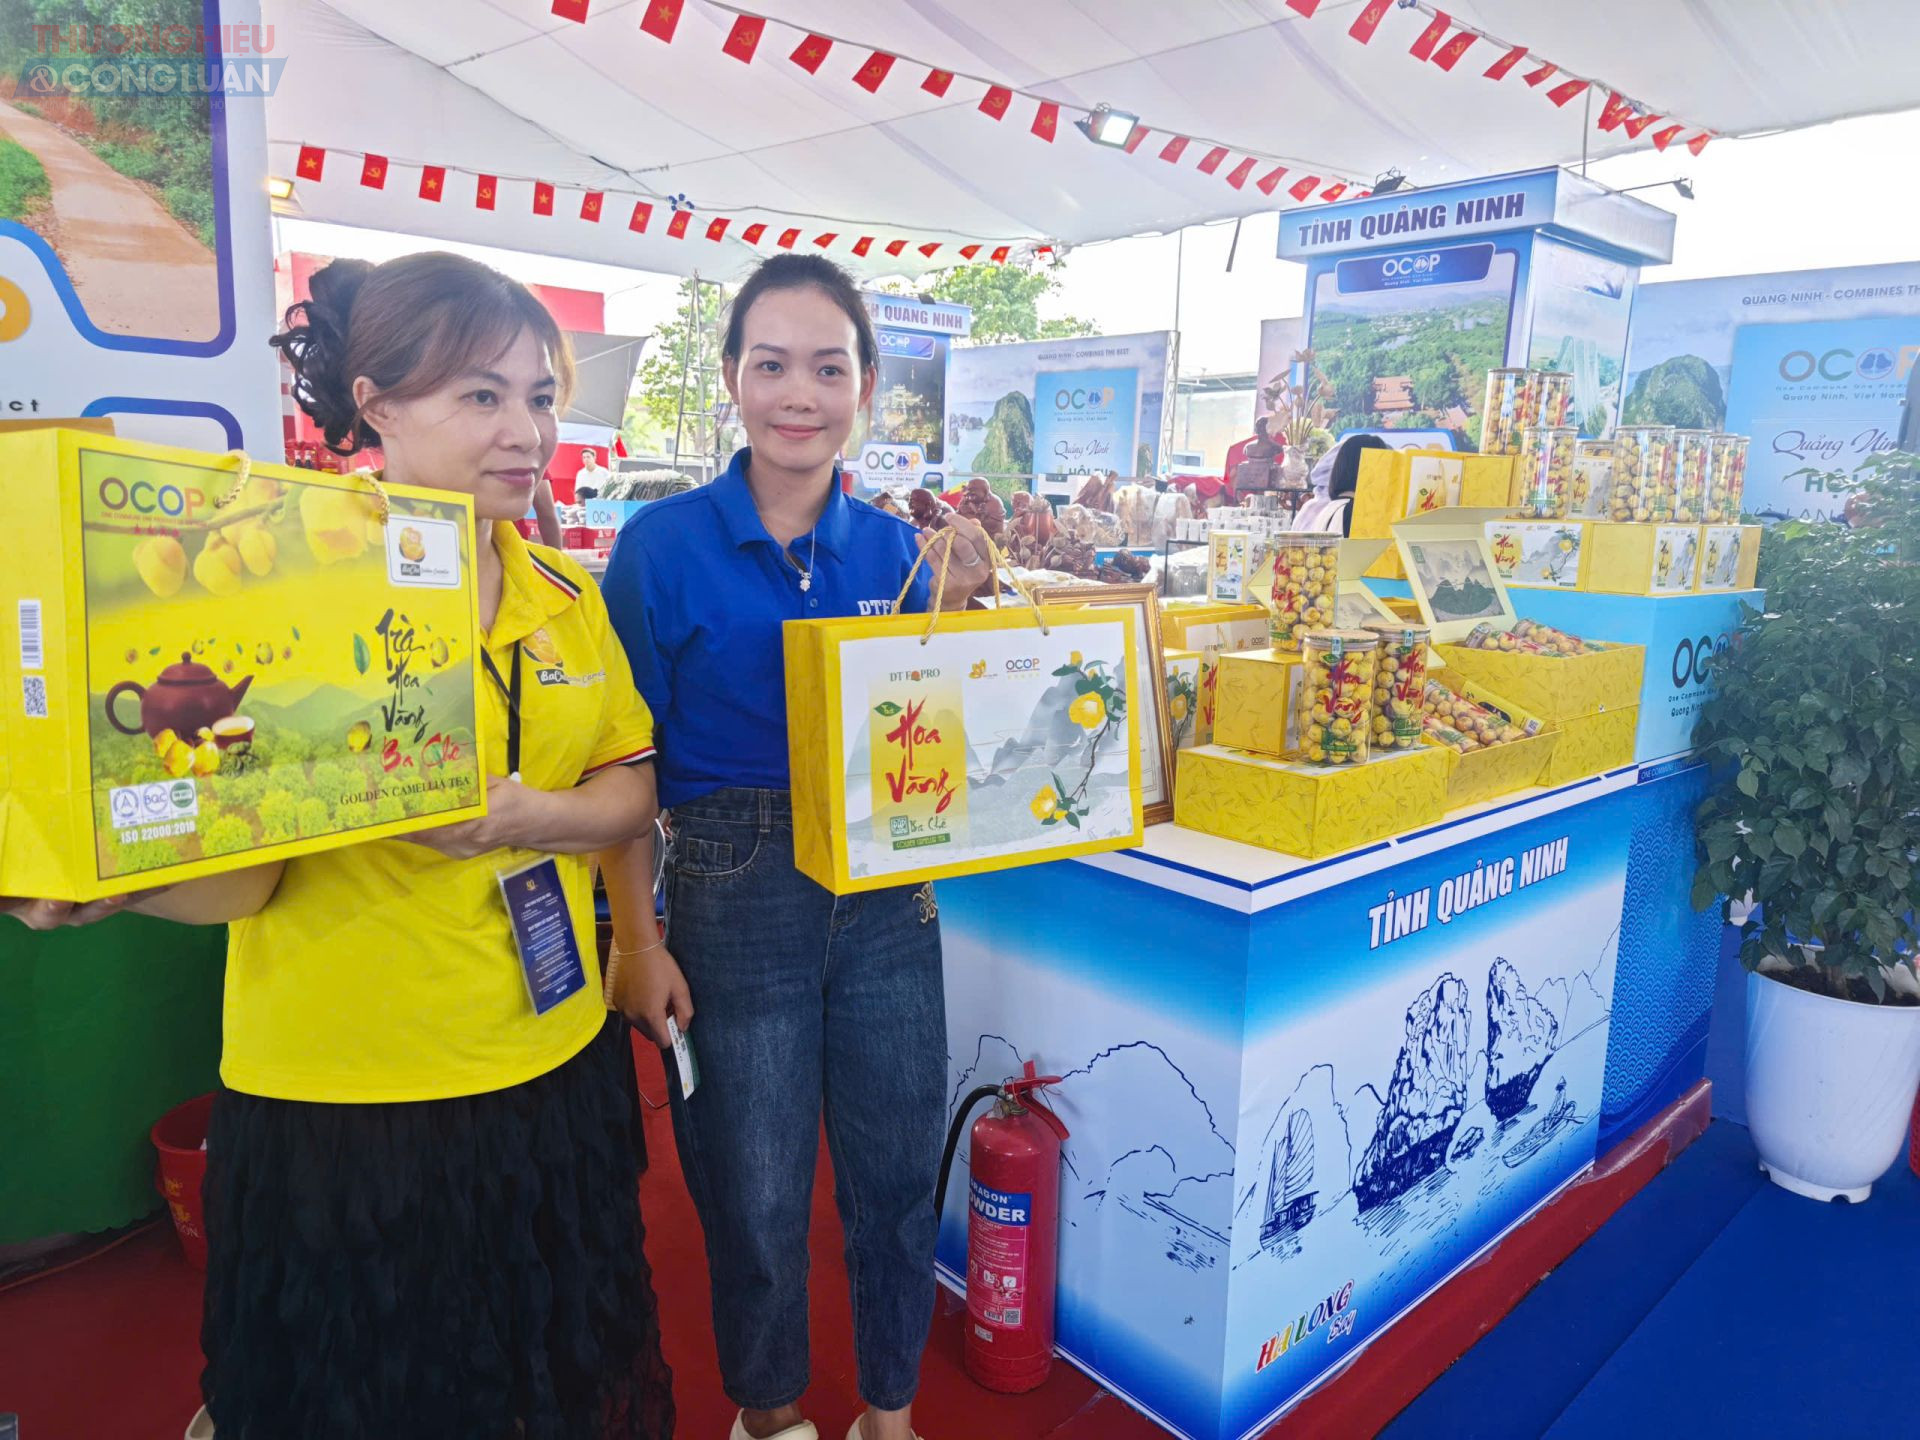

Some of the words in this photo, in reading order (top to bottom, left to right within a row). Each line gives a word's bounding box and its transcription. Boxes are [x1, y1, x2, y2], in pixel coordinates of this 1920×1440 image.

[1298, 218, 1352, 247] TỈNH
[1360, 204, 1447, 240] QUẢNG
[1455, 193, 1525, 226] NINH
[1742, 294, 1787, 306] QUANG
[1791, 292, 1822, 302] NINH
[1833, 285, 1903, 300] COMBINES
[932, 312, 963, 329] NINH
[1772, 430, 1844, 461] Quảng
[99, 477, 206, 518] OCOP
[1005, 657, 1040, 671] OCOP
[885, 695, 942, 771] Hoa
[380, 735, 414, 773] Ba
[340, 788, 390, 806] GOLDEN
[391, 779, 446, 797] CAMELLIA
[448, 776, 470, 790] TEA
[121, 830, 138, 844] ISO
[1368, 889, 1431, 950] TỈNH
[1436, 857, 1515, 924] QUẢNG
[1519, 835, 1569, 890] NINH
[1293, 1279, 1354, 1346] LONG
